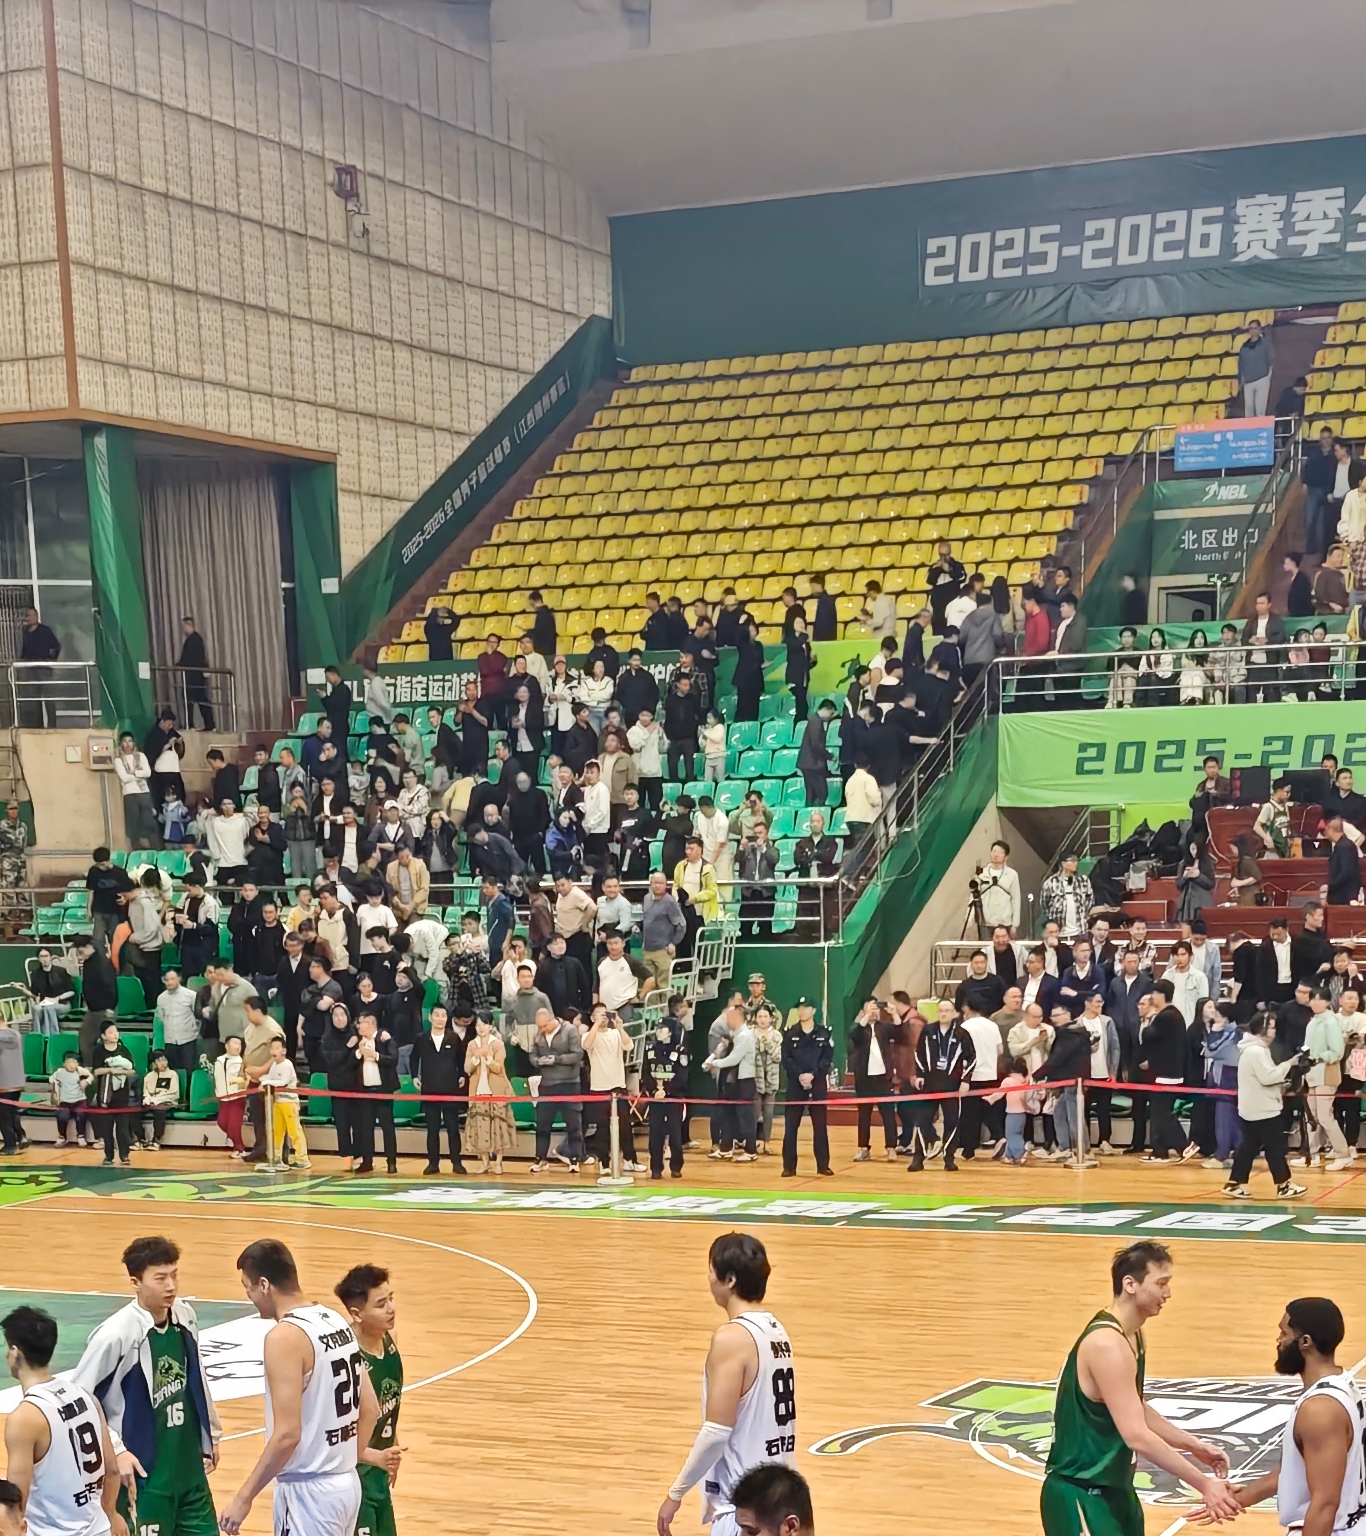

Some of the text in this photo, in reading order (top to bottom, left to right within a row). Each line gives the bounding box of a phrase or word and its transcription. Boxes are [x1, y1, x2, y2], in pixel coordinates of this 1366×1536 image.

[1216, 484, 1248, 501] NBL
[166, 1401, 185, 1428] 16
[69, 1420, 103, 1478] 19
